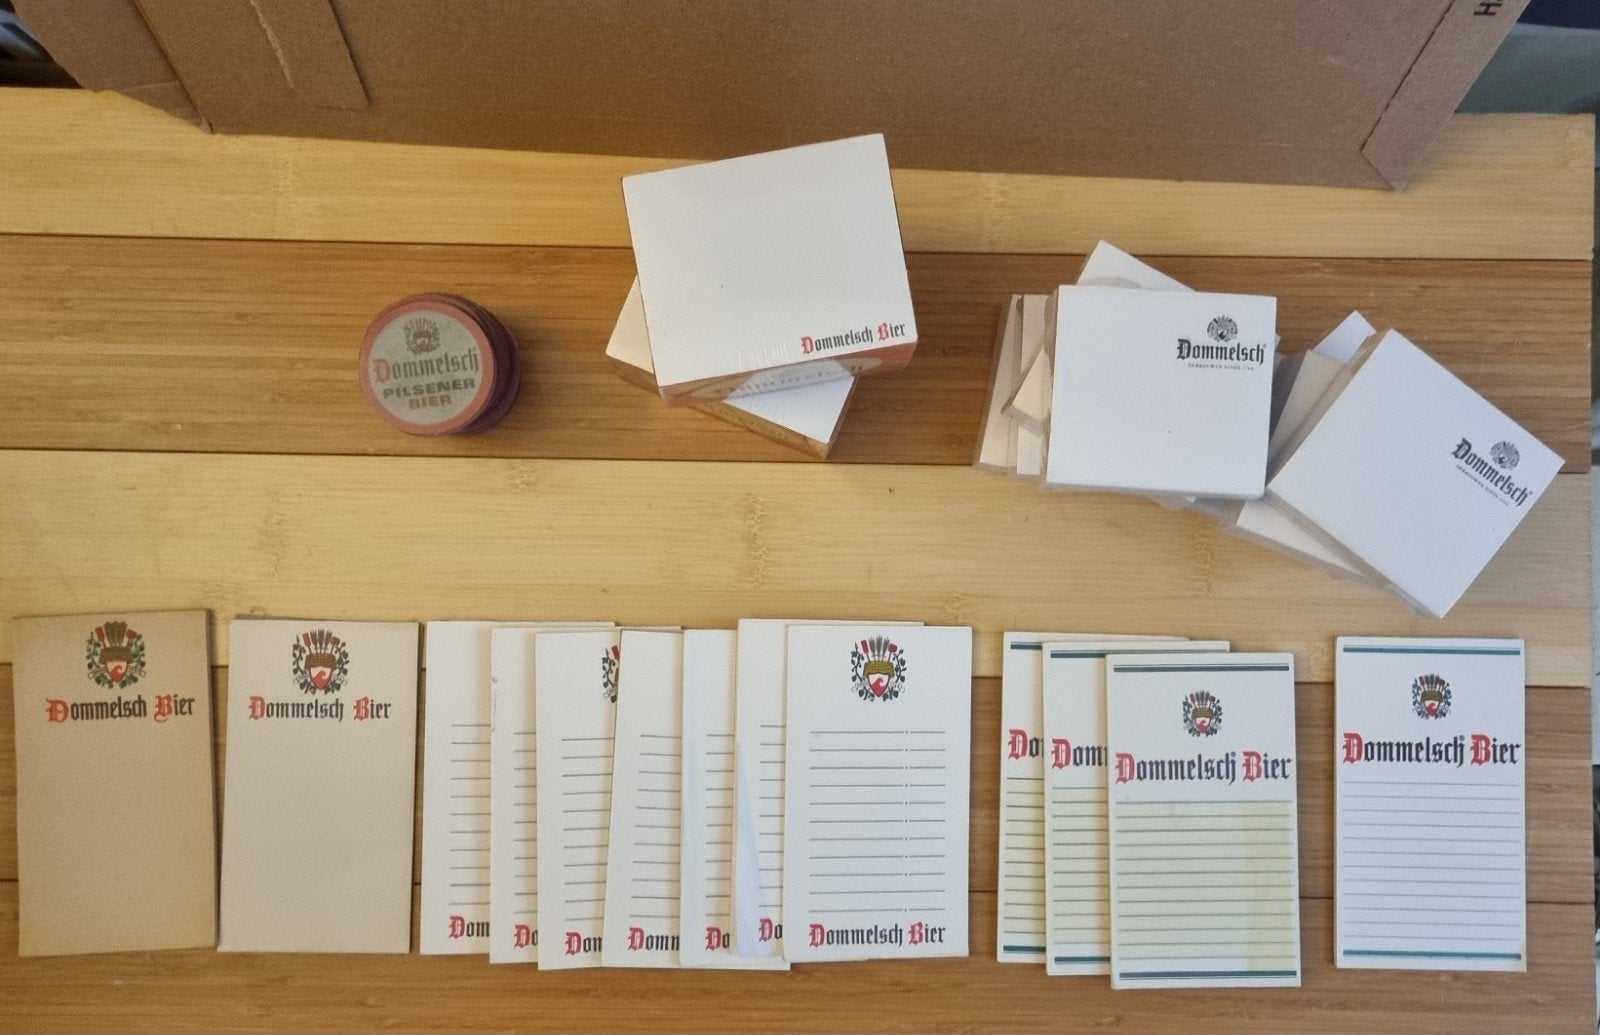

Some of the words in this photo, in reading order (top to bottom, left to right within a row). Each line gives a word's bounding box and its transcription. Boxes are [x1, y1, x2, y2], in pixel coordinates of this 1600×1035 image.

[801, 324, 873, 354] Dommelsch
[877, 322, 906, 341] Bier
[1177, 338, 1264, 366] Dommelsch
[373, 346, 479, 383] Dommelsch
[383, 377, 475, 399] PILSENER
[408, 394, 452, 410] BIER
[1451, 438, 1528, 507] Dommelsch
[46, 695, 147, 723] Dommelsch
[154, 694, 195, 722] Bier
[249, 696, 344, 723] Dommelsch
[353, 696, 391, 721] Bier
[1343, 733, 1464, 768] Dommelsch
[1470, 733, 1521, 766] Bier
[1115, 752, 1236, 785] Dommelsch
[1242, 750, 1293, 782] Bier
[809, 923, 903, 948] Dommelsch
[908, 921, 946, 945] Bier
